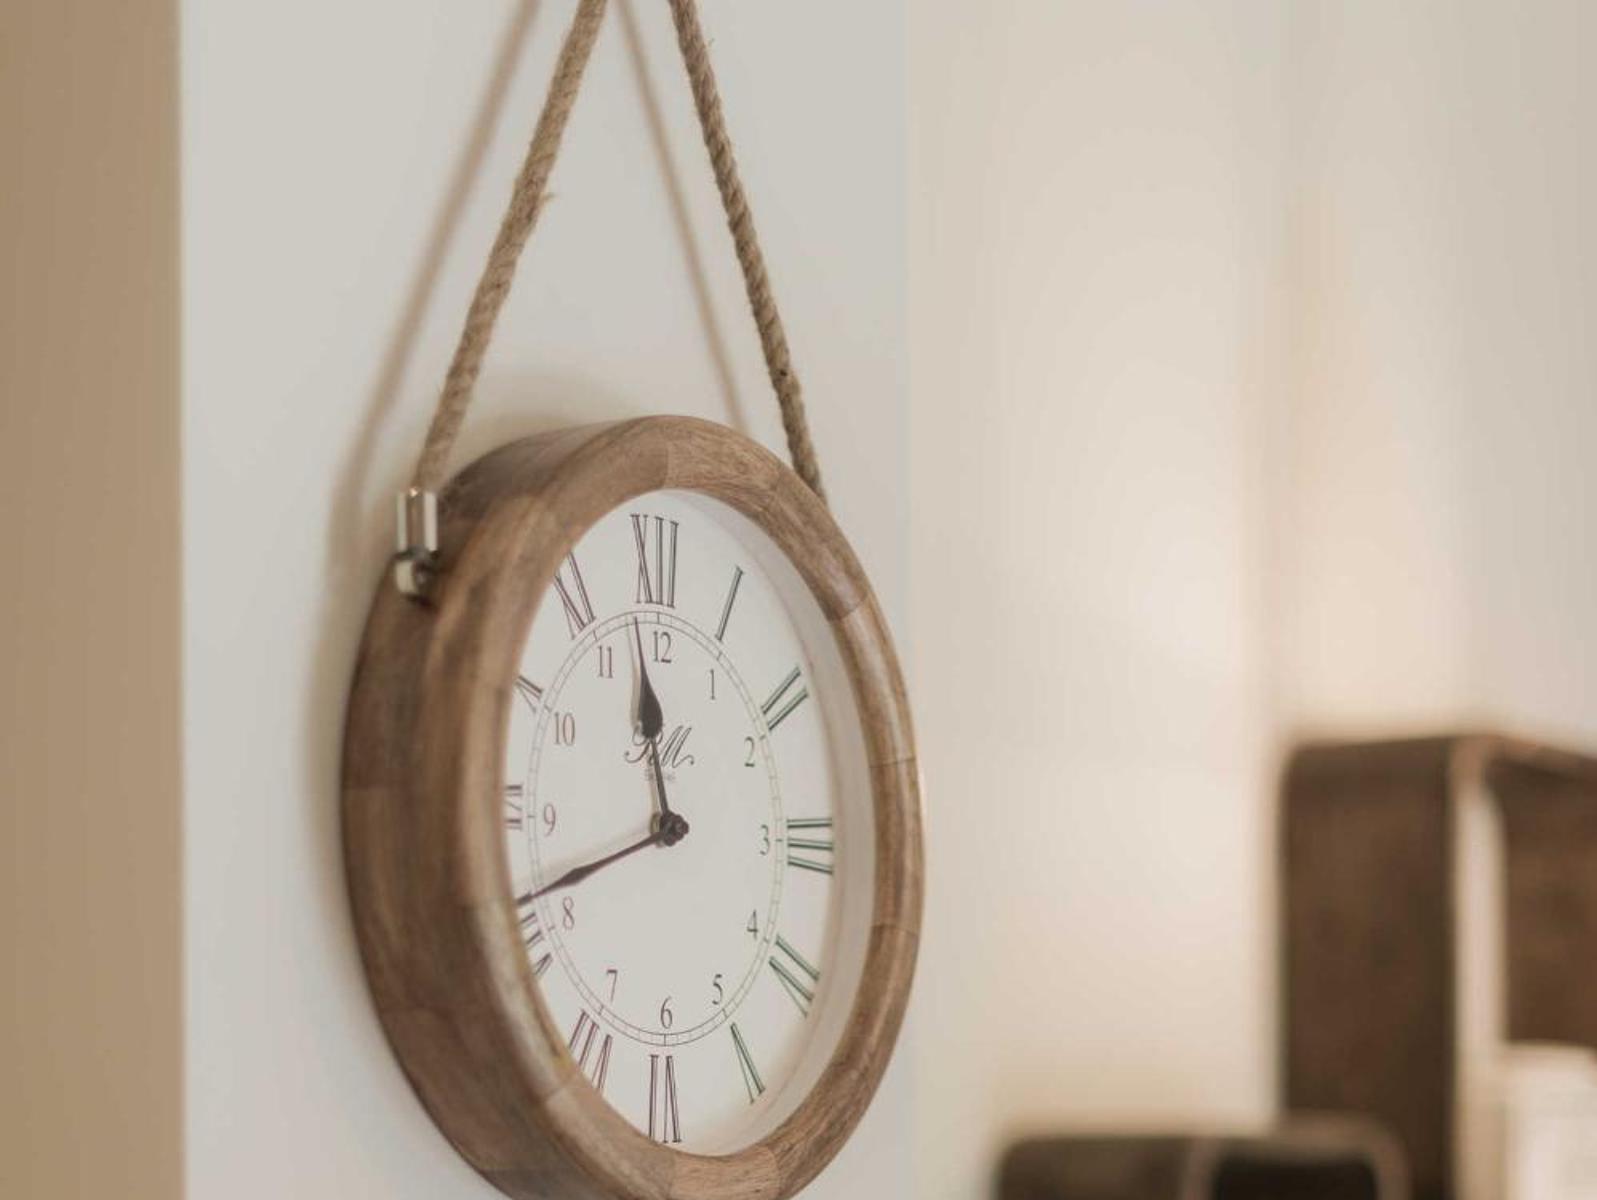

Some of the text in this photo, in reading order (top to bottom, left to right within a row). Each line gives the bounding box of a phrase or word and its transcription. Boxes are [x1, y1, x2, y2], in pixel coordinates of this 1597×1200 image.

[630, 513, 679, 609] XII
[597, 646, 614, 679] 11
[653, 631, 672, 663] 12
[709, 669, 717, 700] 1
[553, 712, 577, 746] 10
[744, 736, 756, 768] 2
[543, 803, 557, 837] 9
[759, 824, 770, 856] 3
[562, 895, 575, 930] 8
[746, 909, 759, 940] 4
[605, 968, 619, 1003] 7
[711, 973, 724, 1006] 5
[659, 996, 674, 1030] 6
